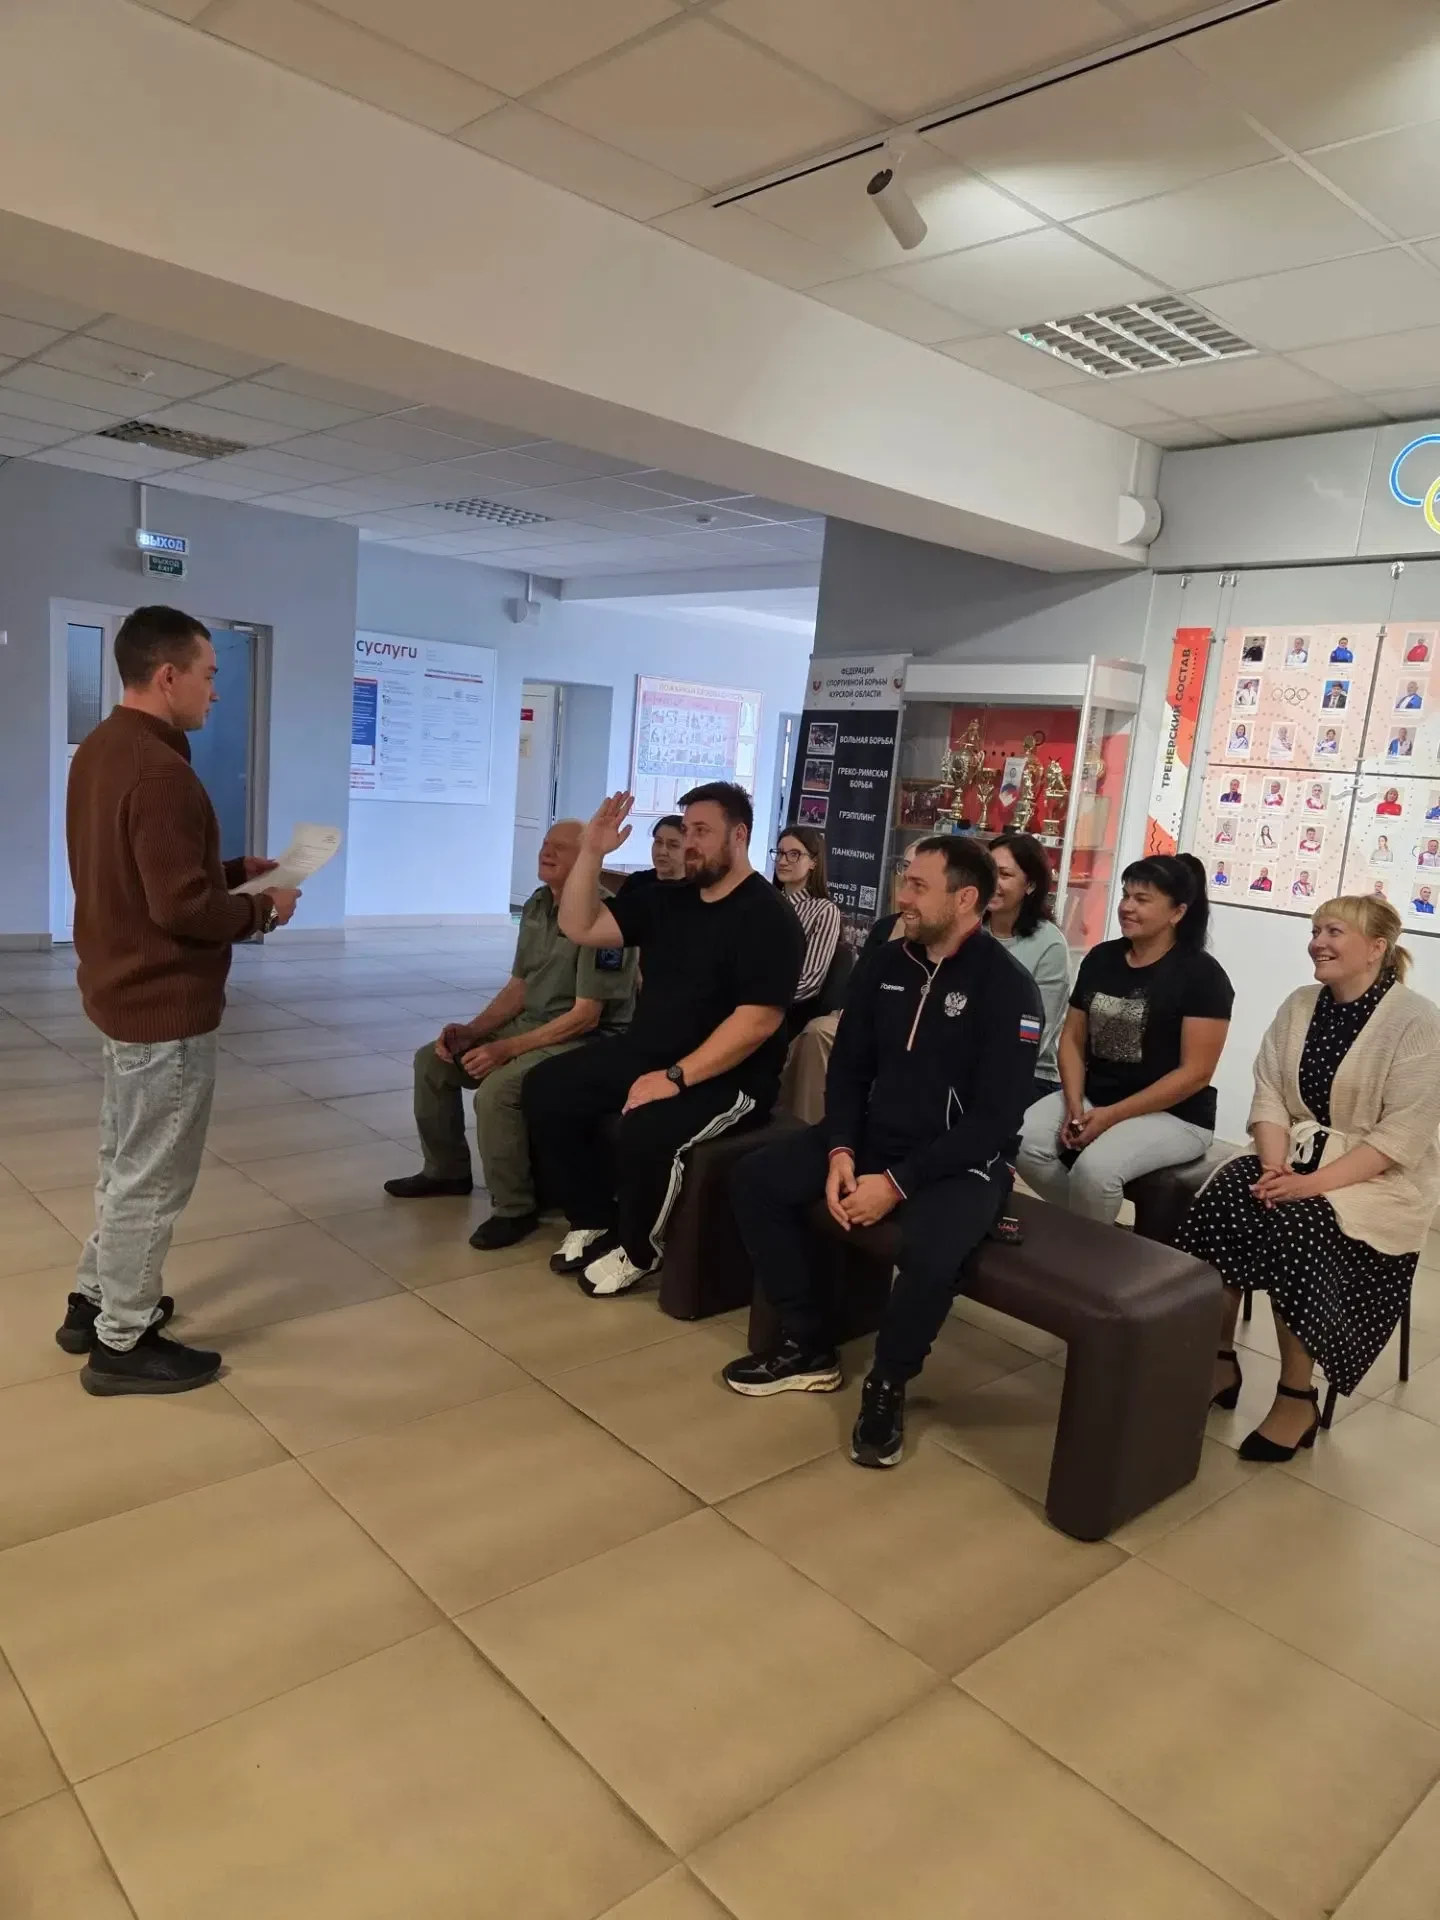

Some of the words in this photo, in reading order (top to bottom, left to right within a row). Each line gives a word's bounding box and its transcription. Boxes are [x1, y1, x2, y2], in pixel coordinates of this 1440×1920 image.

[141, 534, 184, 551] ВЫХОД
[840, 666, 875, 675] ФЕДЕРАЦИЯ
[826, 677, 864, 687] СПОРТИВНОЙ
[864, 678, 888, 686] БОРЬБЫ
[829, 690, 854, 698] КУРСКОЙ
[855, 690, 881, 698] ОБЛАСТИ
[1161, 704, 1181, 789] ТРЕНЕРСКИЙ
[1175, 648, 1191, 702] СОСТАВ
[839, 736, 868, 744] ВОЛЬНАЯ
[869, 736, 894, 745] БОРЬБА
[838, 767, 889, 778] ГРЕКО-РИМСКАЯ
[849, 780, 873, 789] БОРЬБА
[839, 810, 876, 822] ГРЭППЛИНГ
[831, 847, 875, 860] ПАНКРАТИОН
[833, 892, 844, 904] 59
[846, 895, 855, 906] 11
